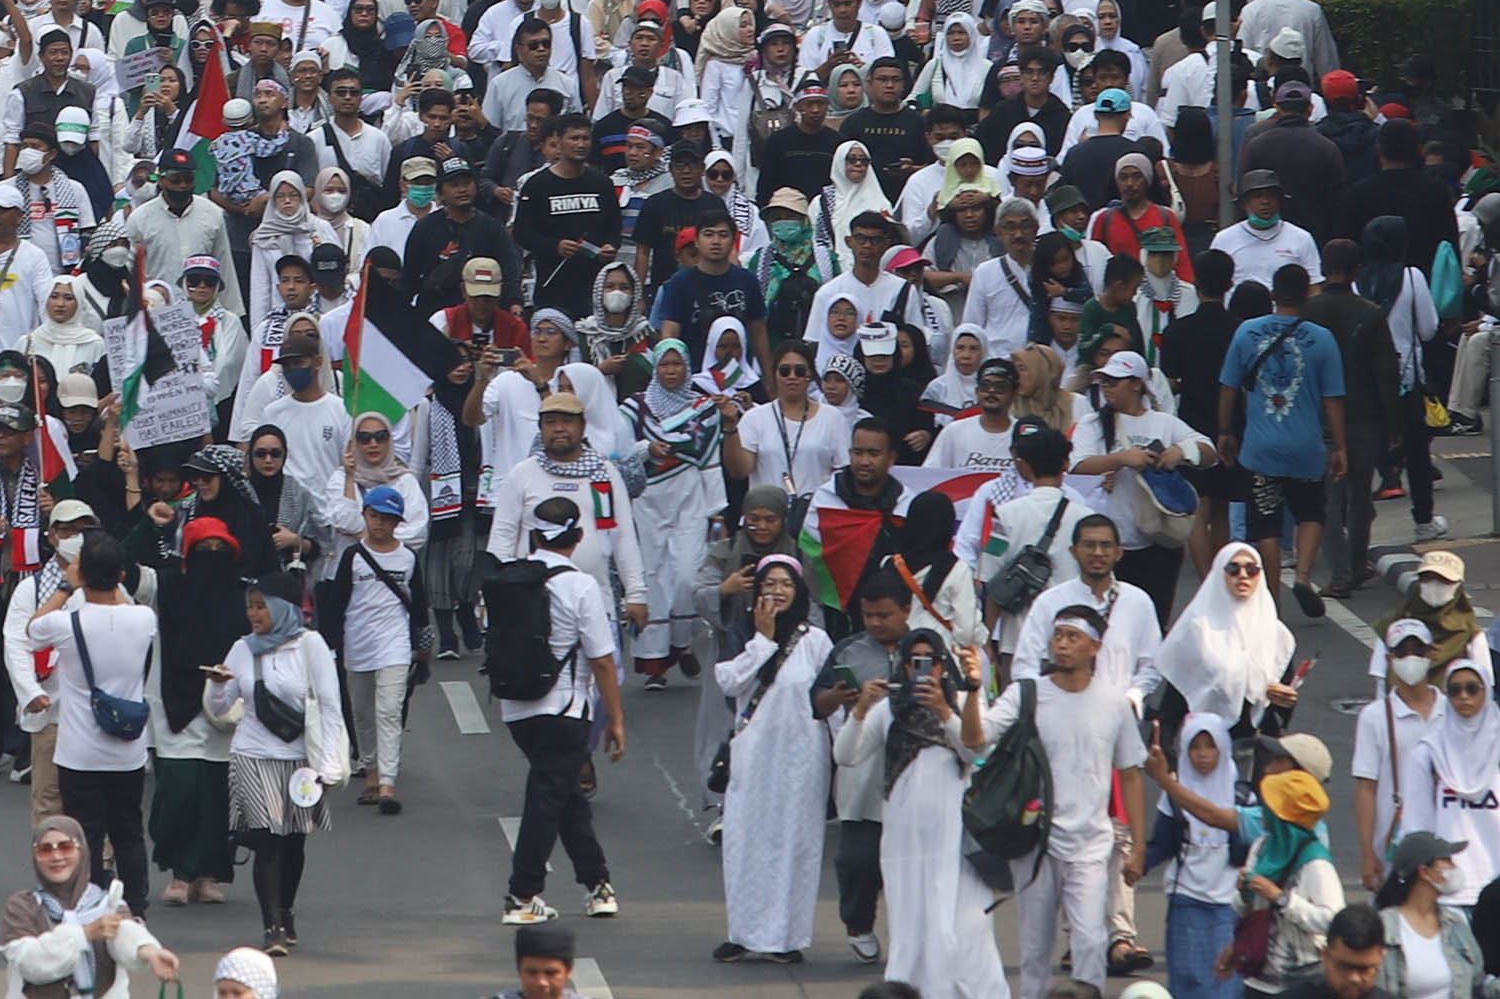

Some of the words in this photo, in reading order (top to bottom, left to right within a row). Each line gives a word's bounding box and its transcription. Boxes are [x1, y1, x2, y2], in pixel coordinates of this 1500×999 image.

[550, 197, 600, 211] RIMYA
[964, 452, 1013, 468] Bara
[17, 491, 37, 524] SAVE
